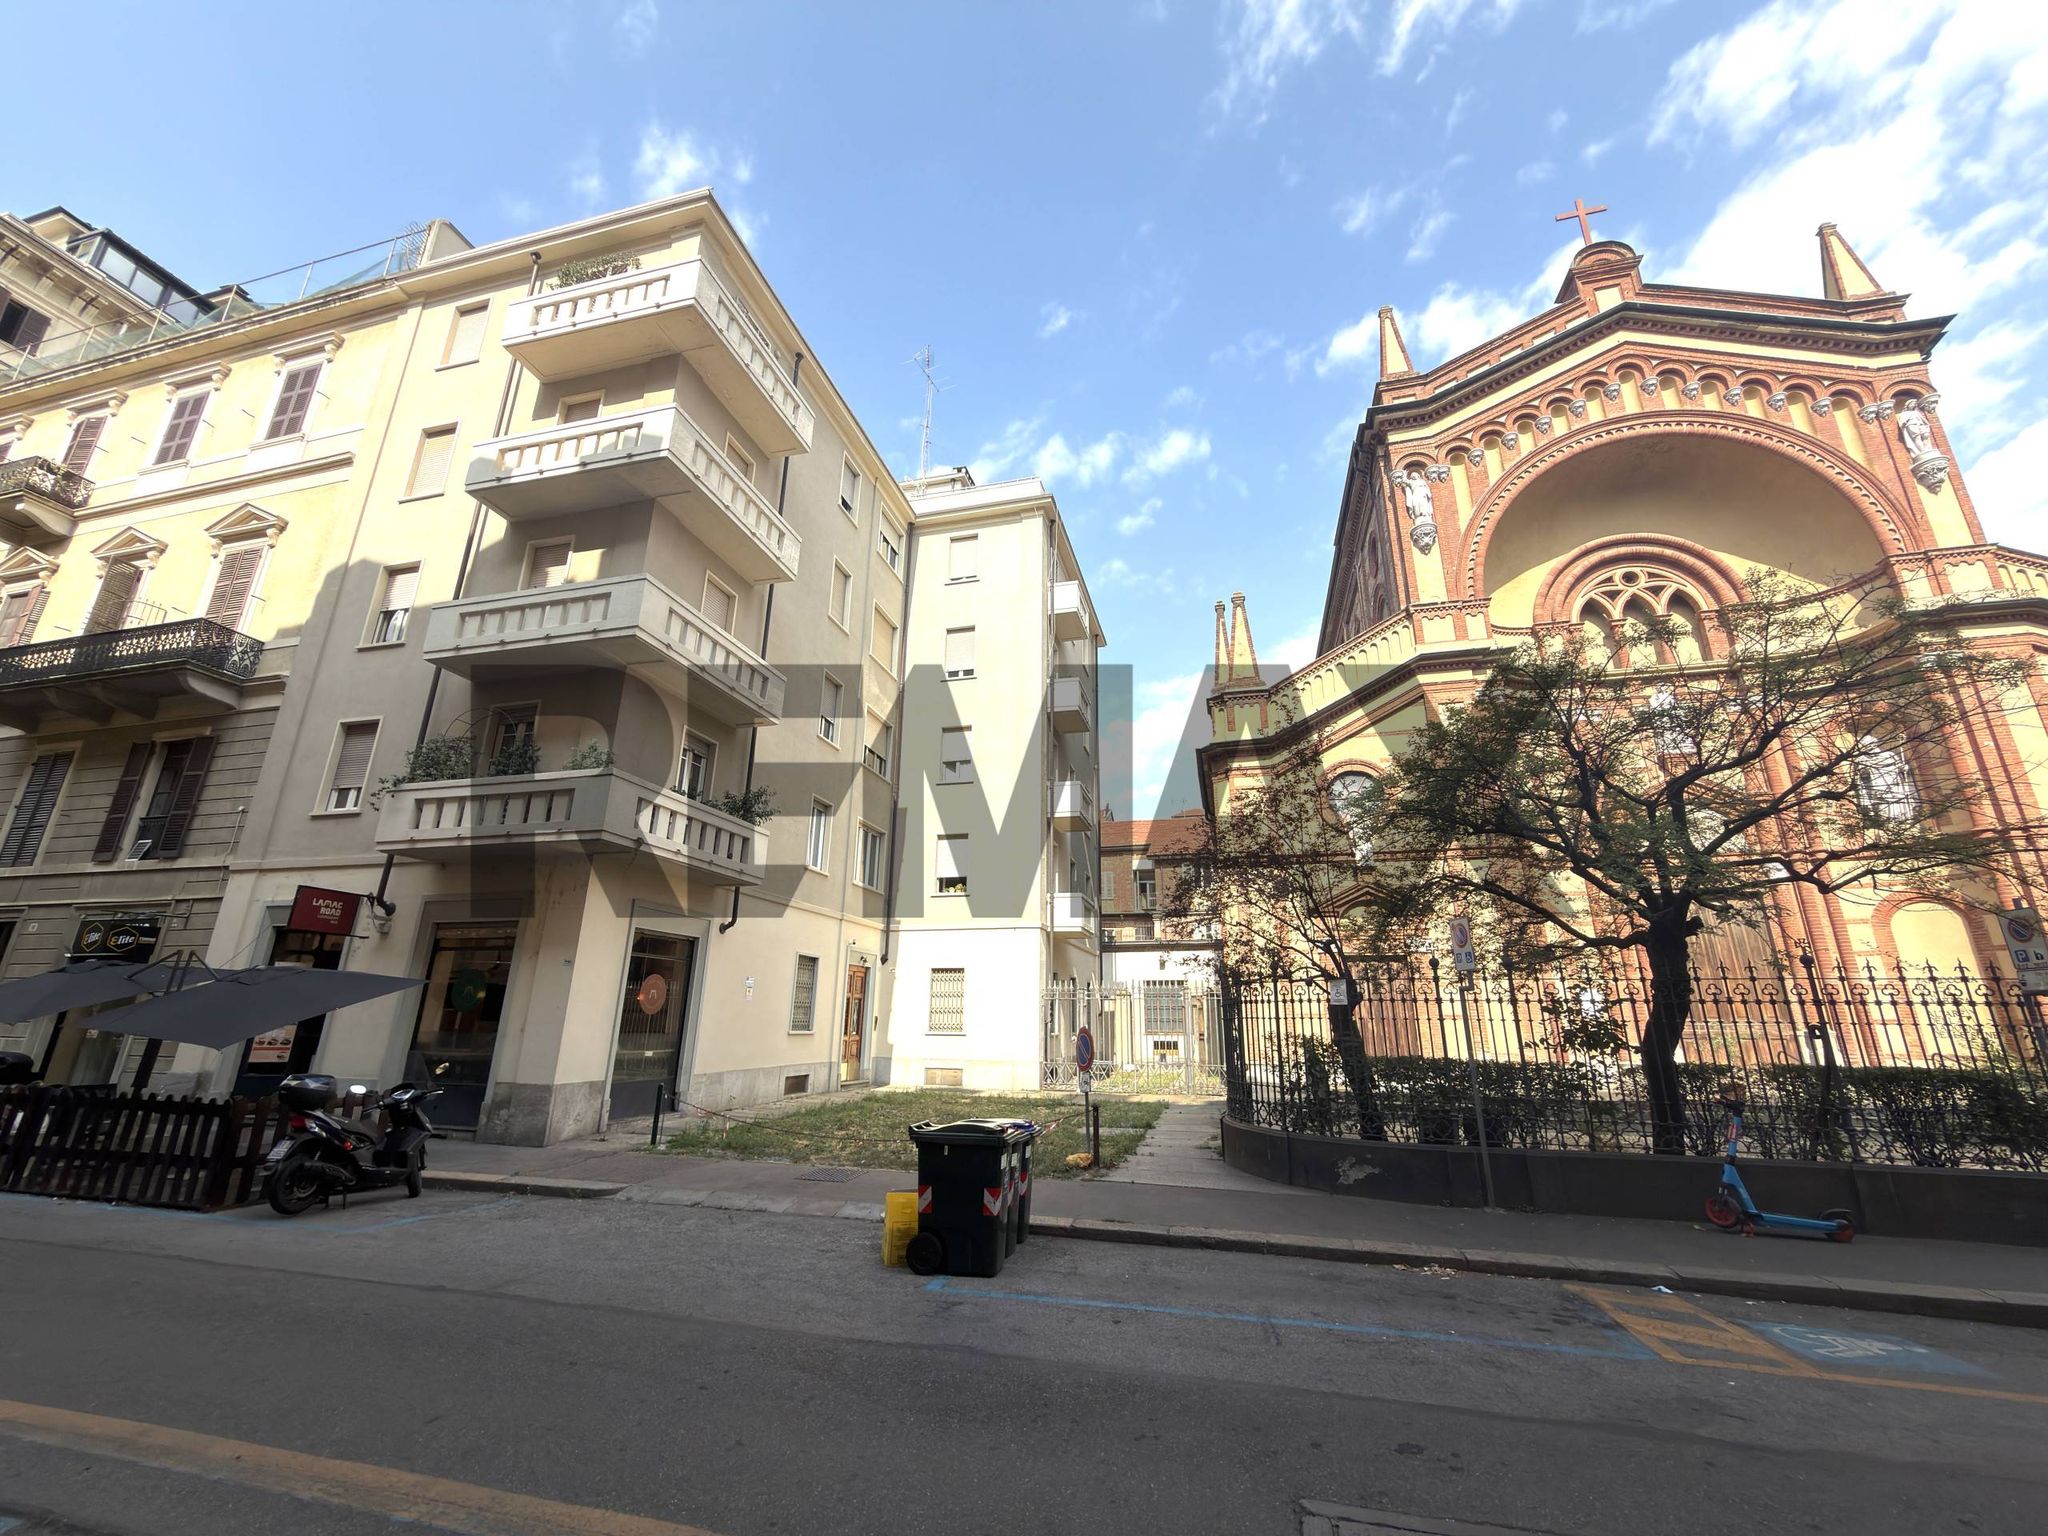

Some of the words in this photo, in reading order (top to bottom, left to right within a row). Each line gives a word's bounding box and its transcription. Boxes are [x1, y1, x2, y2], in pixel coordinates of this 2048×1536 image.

[312, 897, 343, 909] LAMAC
[319, 907, 342, 916] ROAD
[110, 935, 135, 946] Elite
